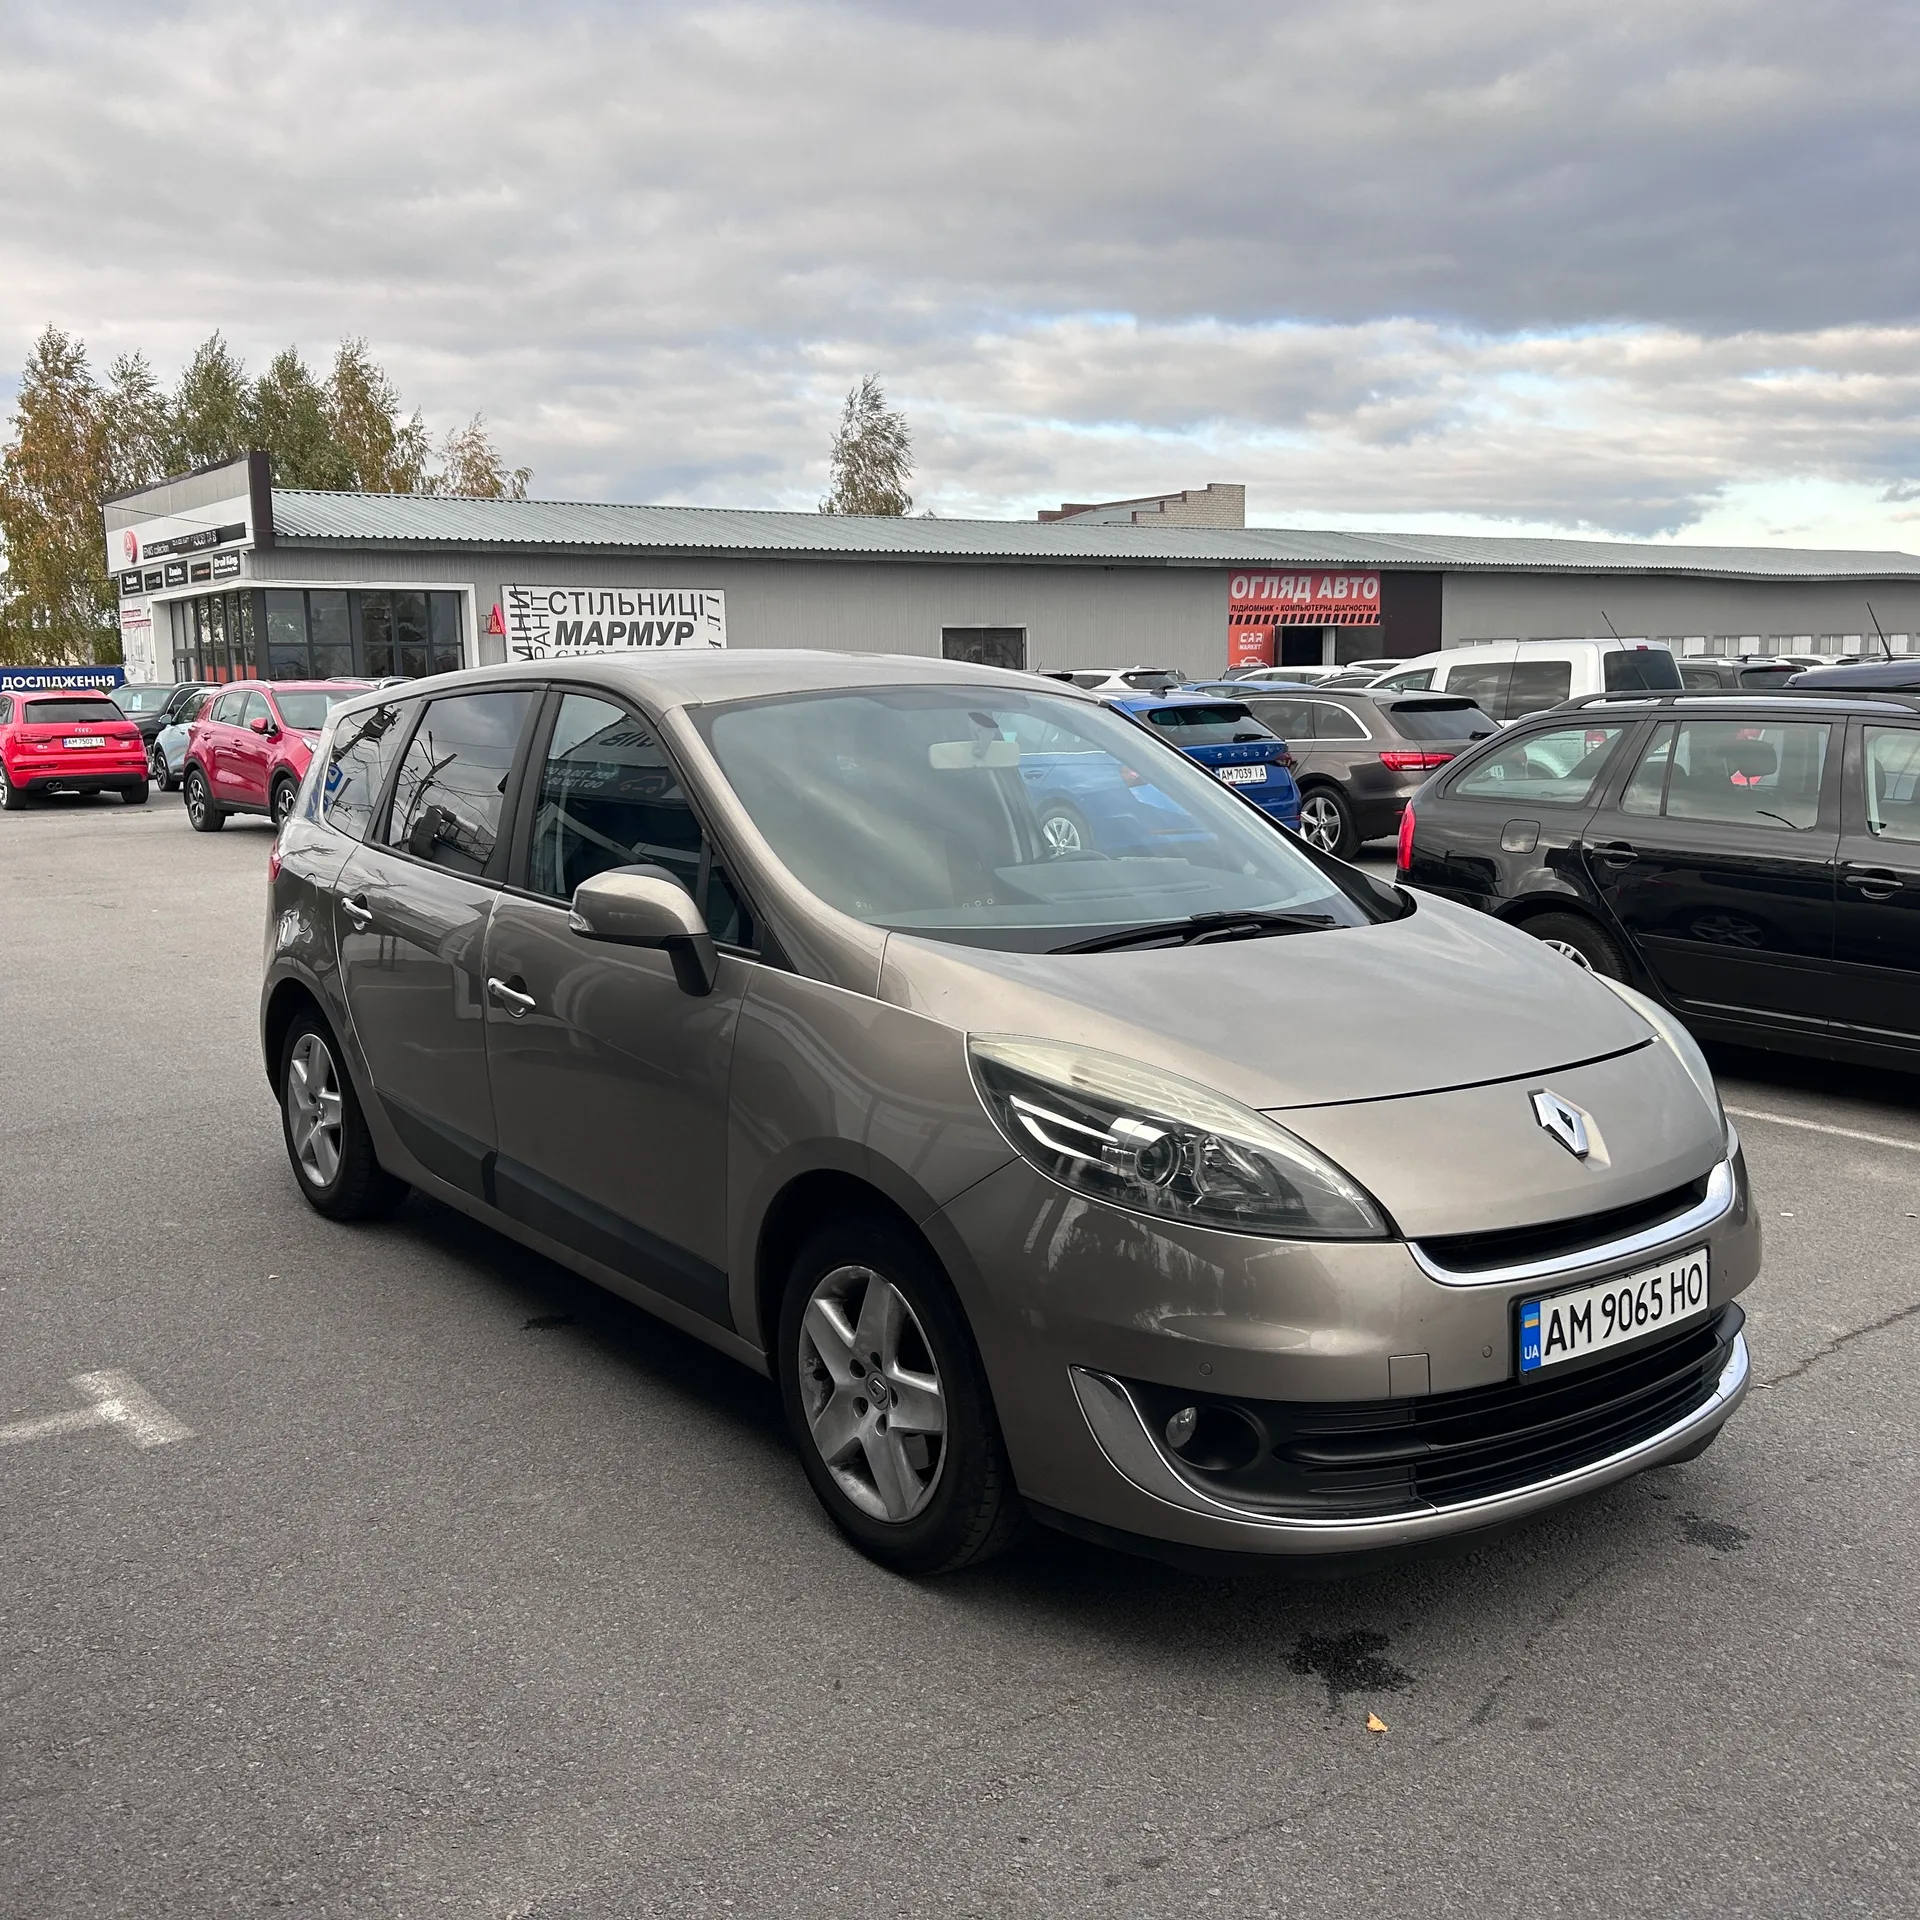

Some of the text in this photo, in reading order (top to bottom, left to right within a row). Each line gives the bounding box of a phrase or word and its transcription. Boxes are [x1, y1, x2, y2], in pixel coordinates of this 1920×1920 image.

[1231, 575, 1378, 603] ОГЛЯД АВТО
[548, 590, 704, 621] СТІЛЬНИЦІ
[1230, 604, 1274, 613] ПІДЙОМНИК
[554, 620, 695, 646] МАРМУР
[1, 675, 116, 690] ДОСЛІДЖЕННЯ
[1221, 770, 1234, 780] AM
[1234, 768, 1252, 779] 7039
[1544, 1263, 1702, 1356] AM 9065 HO
[1524, 1344, 1539, 1360] UA
